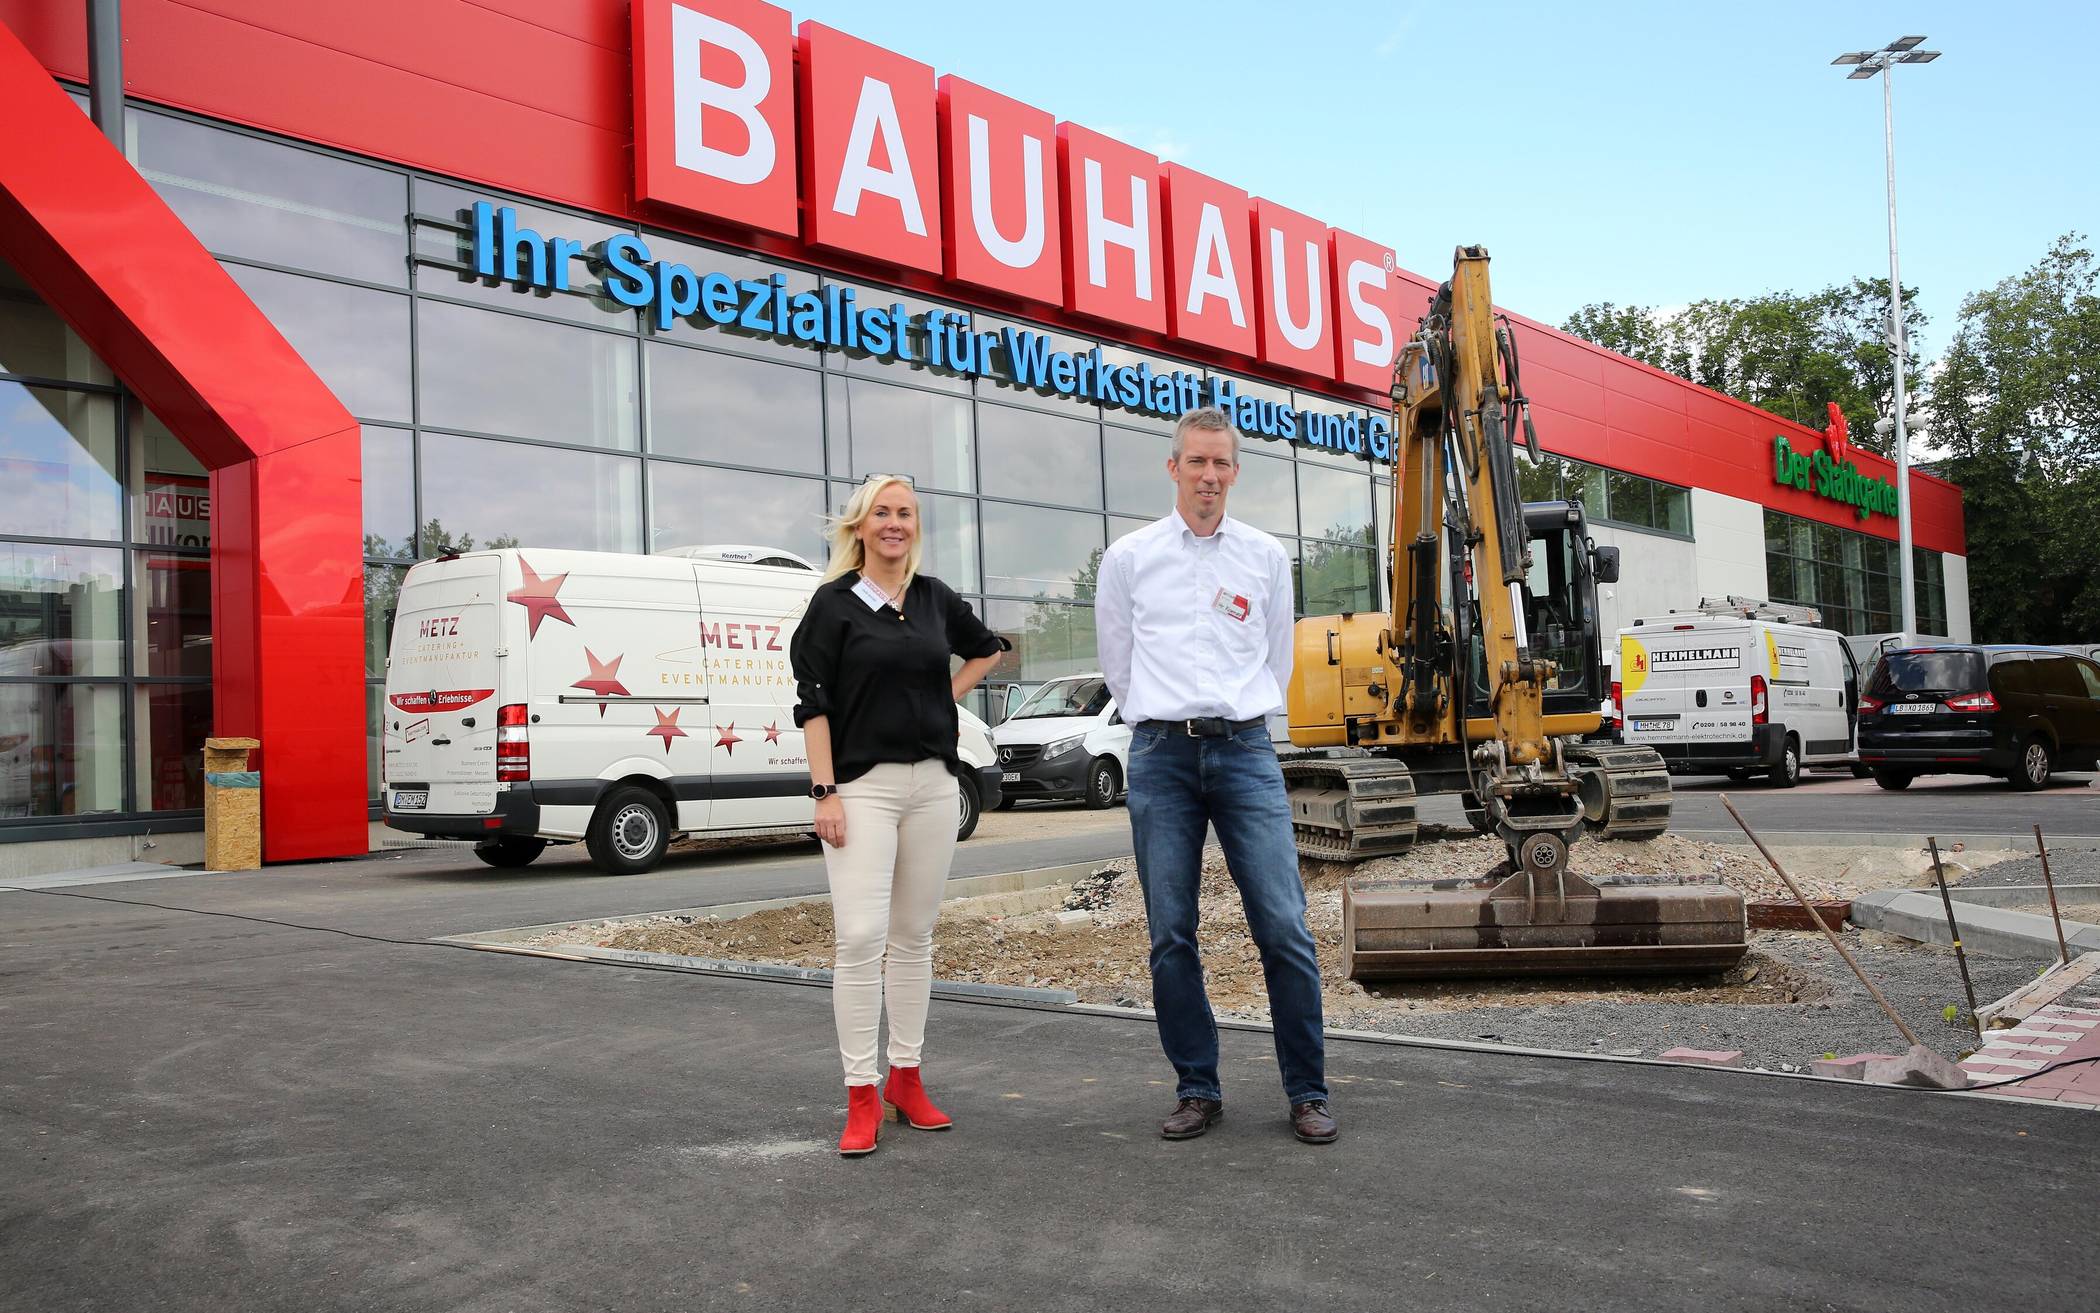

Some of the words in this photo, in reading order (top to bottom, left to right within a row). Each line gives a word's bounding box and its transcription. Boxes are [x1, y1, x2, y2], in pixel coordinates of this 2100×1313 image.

[671, 2, 1393, 368] BAUHAUS
[472, 199, 584, 291] Ihr
[600, 233, 914, 361] Spezialist
[924, 308, 999, 378] für
[1005, 327, 1202, 416] Werkstatt
[1208, 376, 1298, 441] Haus
[1303, 411, 1362, 455] und
[1775, 434, 1811, 492] Der
[1812, 448, 1899, 520] Stadtgarte
[419, 616, 460, 639] METZ
[698, 622, 783, 652] METZ
[417, 641, 457, 653] CATERING
[1652, 647, 1740, 662] HEMMELMANN
[402, 650, 479, 665] EVENTMANUFAKTUR
[702, 658, 785, 671] CATERING
[660, 672, 794, 687] EVENTMANUFAK
[396, 696, 405, 706] Wir
[404, 695, 427, 705] schaffen
[438, 693, 474, 704] Erlebnisse.
[780, 757, 807, 766] schaffen
